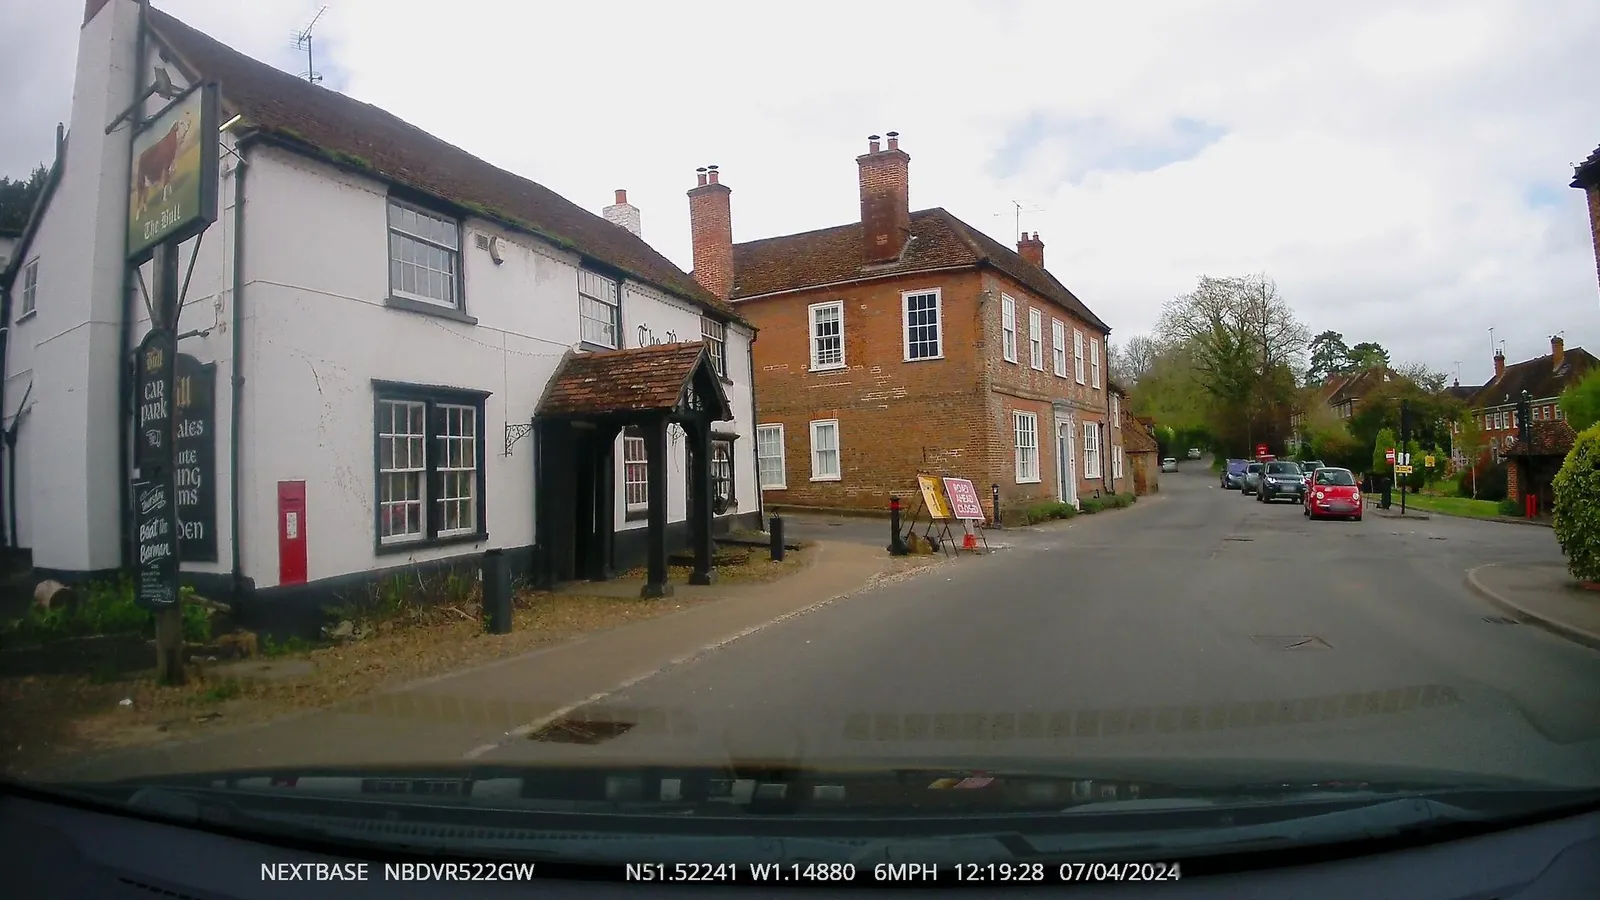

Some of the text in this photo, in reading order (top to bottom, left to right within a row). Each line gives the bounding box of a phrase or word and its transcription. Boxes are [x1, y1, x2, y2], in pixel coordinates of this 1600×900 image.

[144, 204, 181, 239] The Bull
[957, 504, 978, 513] CLOSED
